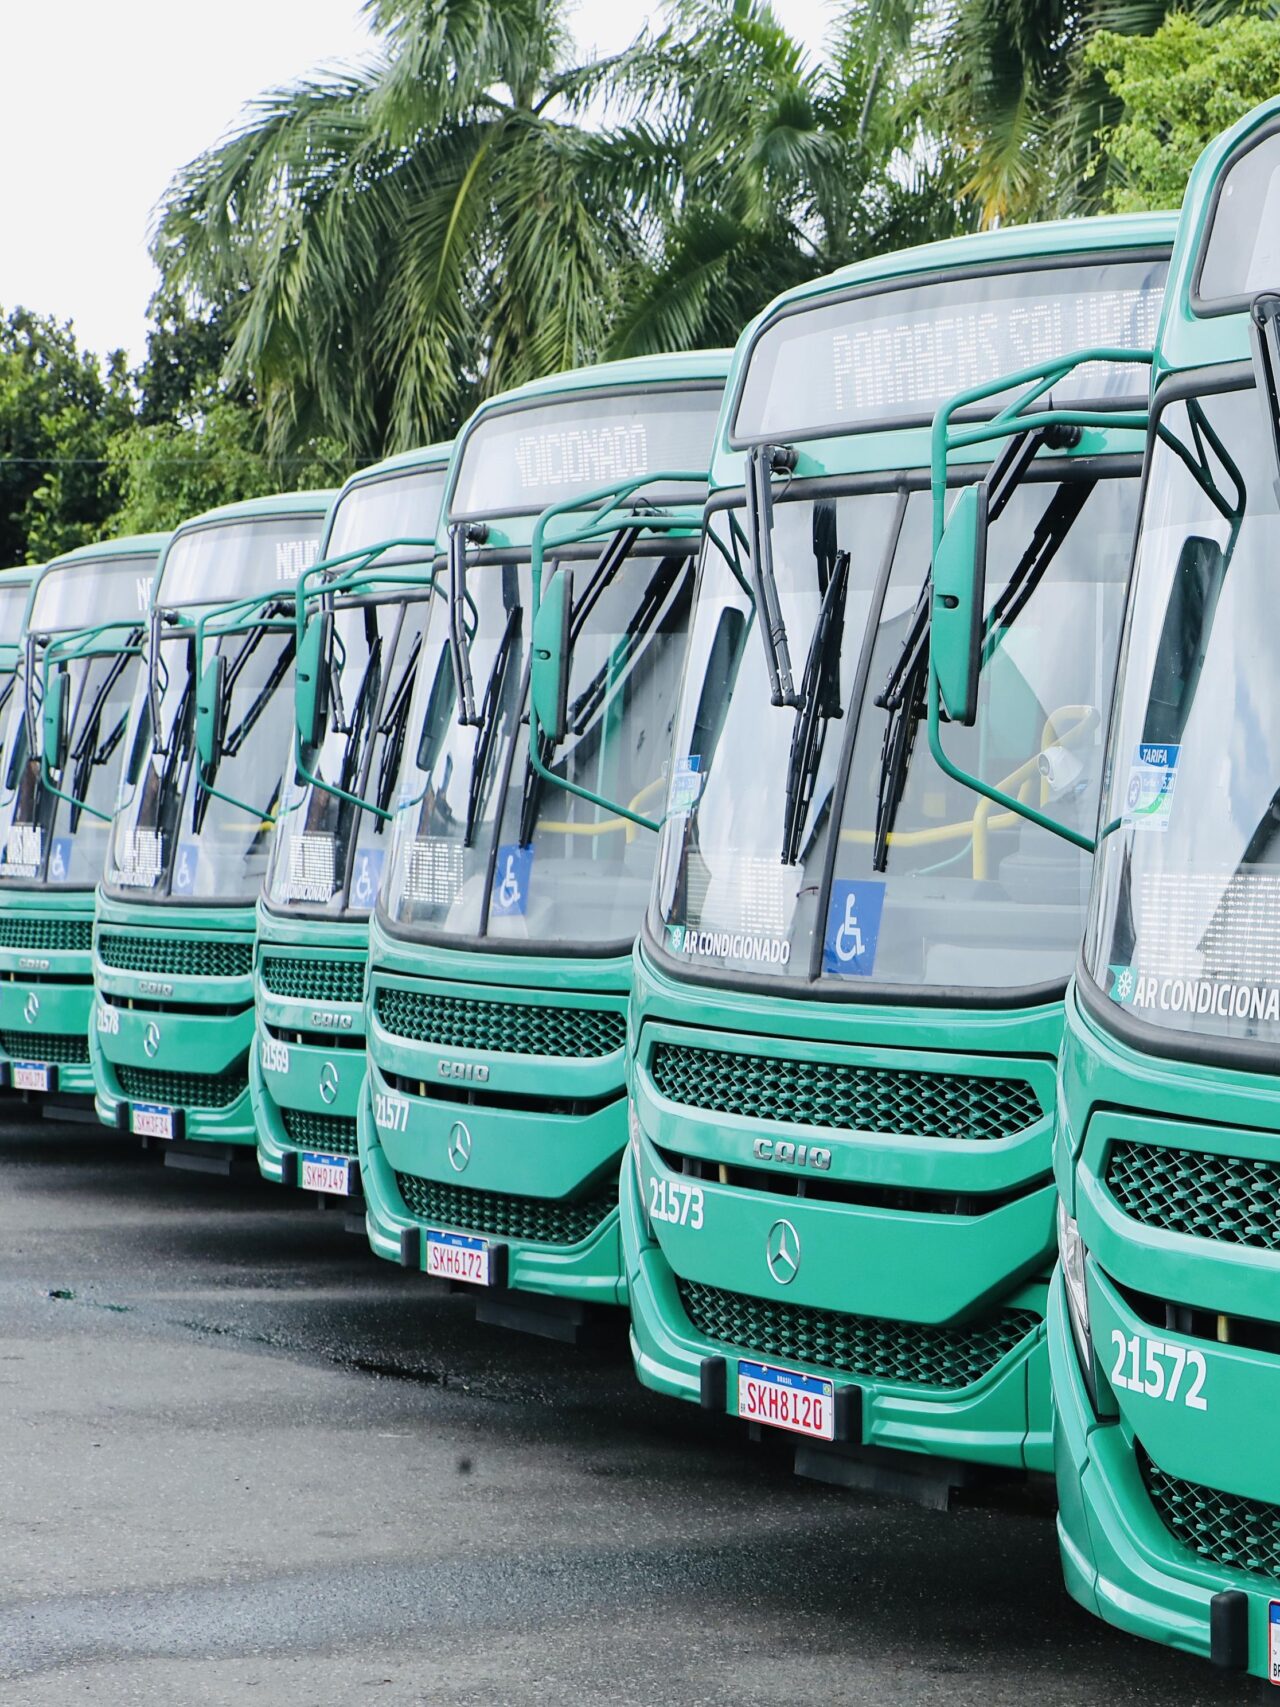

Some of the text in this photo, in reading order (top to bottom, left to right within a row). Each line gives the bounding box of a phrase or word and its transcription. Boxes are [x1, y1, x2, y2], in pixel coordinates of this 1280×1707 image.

[1142, 748, 1168, 763] TARIFA
[683, 931, 791, 965] AR CONDICIONADO
[1133, 977, 1158, 1009] AR
[311, 1012, 353, 1029] CAIO
[438, 1060, 490, 1082] CAIO
[375, 1093, 410, 1132] 21577
[753, 1138, 832, 1170] CAIO
[650, 1176, 704, 1230] 21573
[1111, 1329, 1208, 1411] 21572
